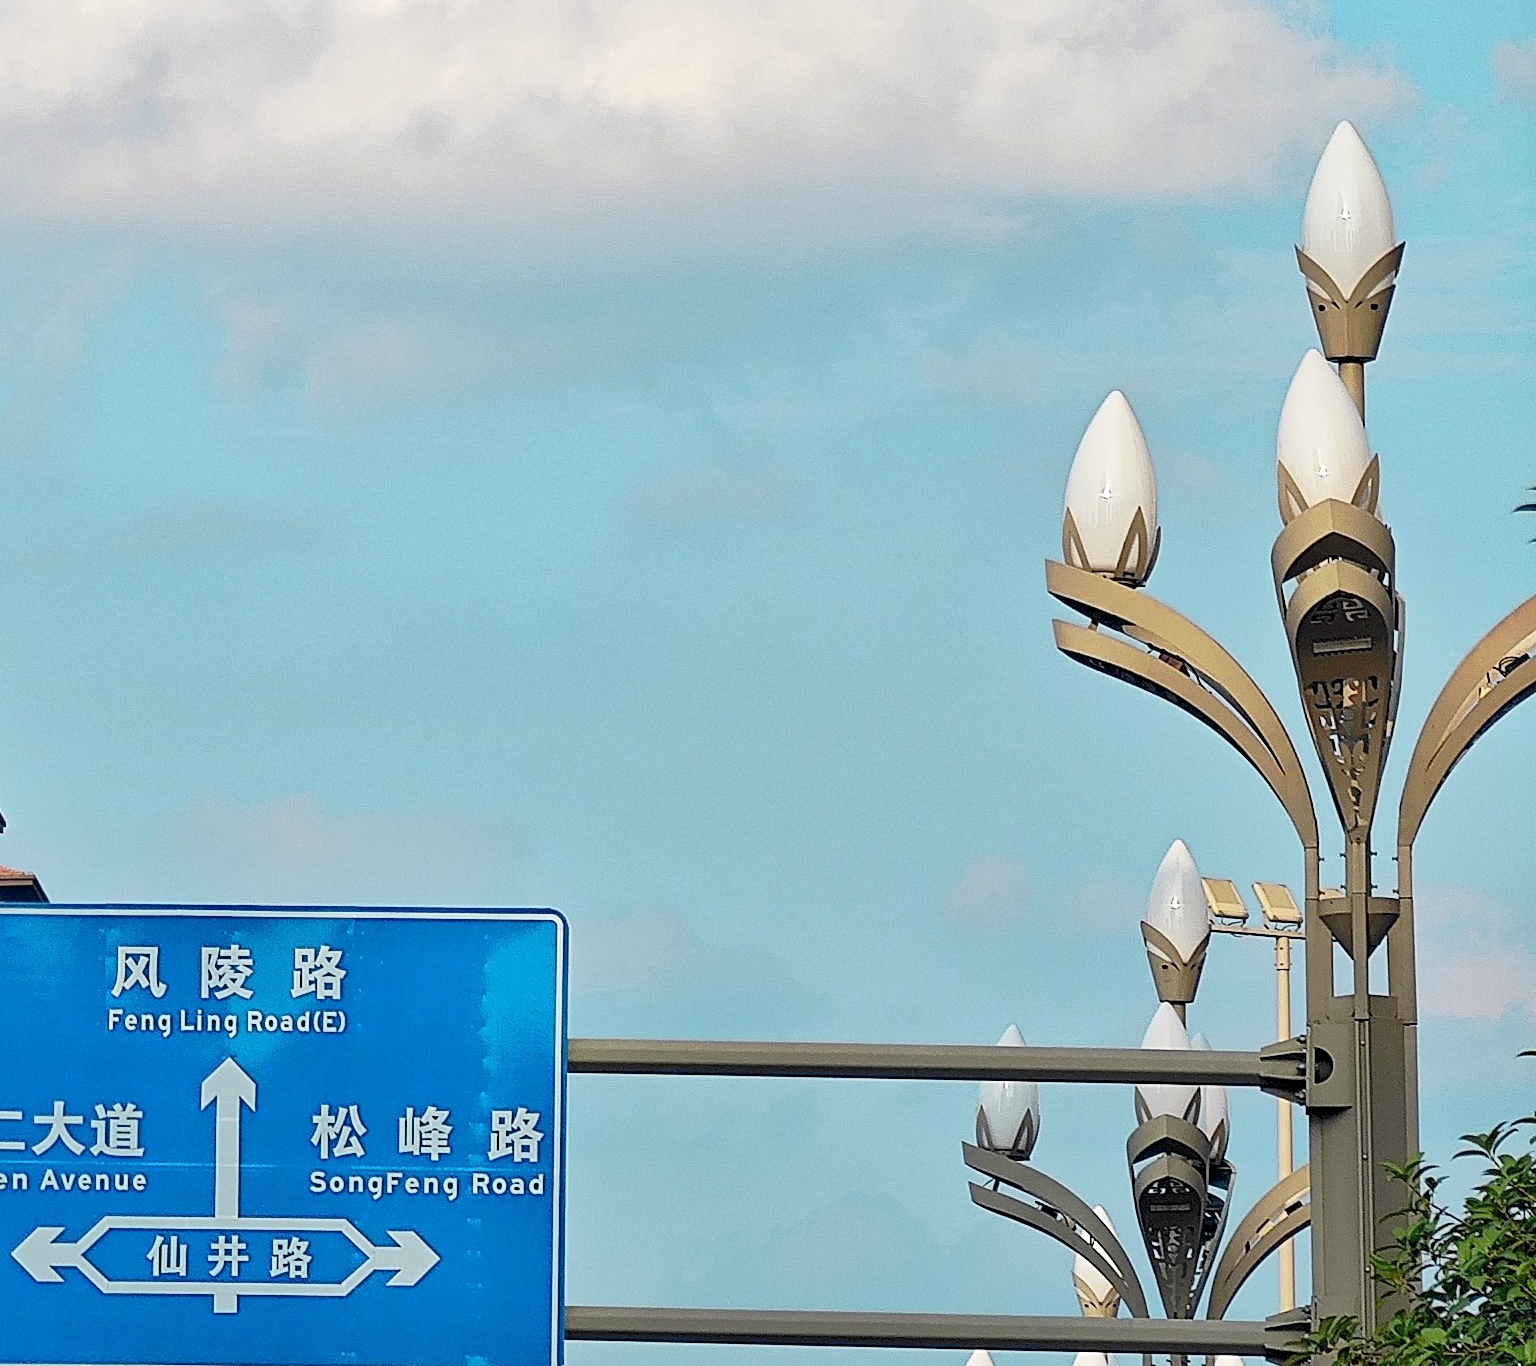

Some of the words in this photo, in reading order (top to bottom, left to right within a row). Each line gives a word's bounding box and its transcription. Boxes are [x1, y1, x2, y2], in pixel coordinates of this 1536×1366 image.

[111, 944, 347, 1001] 风陵路
[108, 1009, 171, 1038] Feng
[180, 1010, 237, 1038] Ling
[247, 1010, 346, 1033] Road(E)
[310, 1104, 544, 1163] 松峰路
[40, 1169, 147, 1191] Avenue
[309, 1171, 458, 1201] SongFeng
[472, 1172, 544, 1195] Road
[147, 1236, 313, 1279] 仙井路
